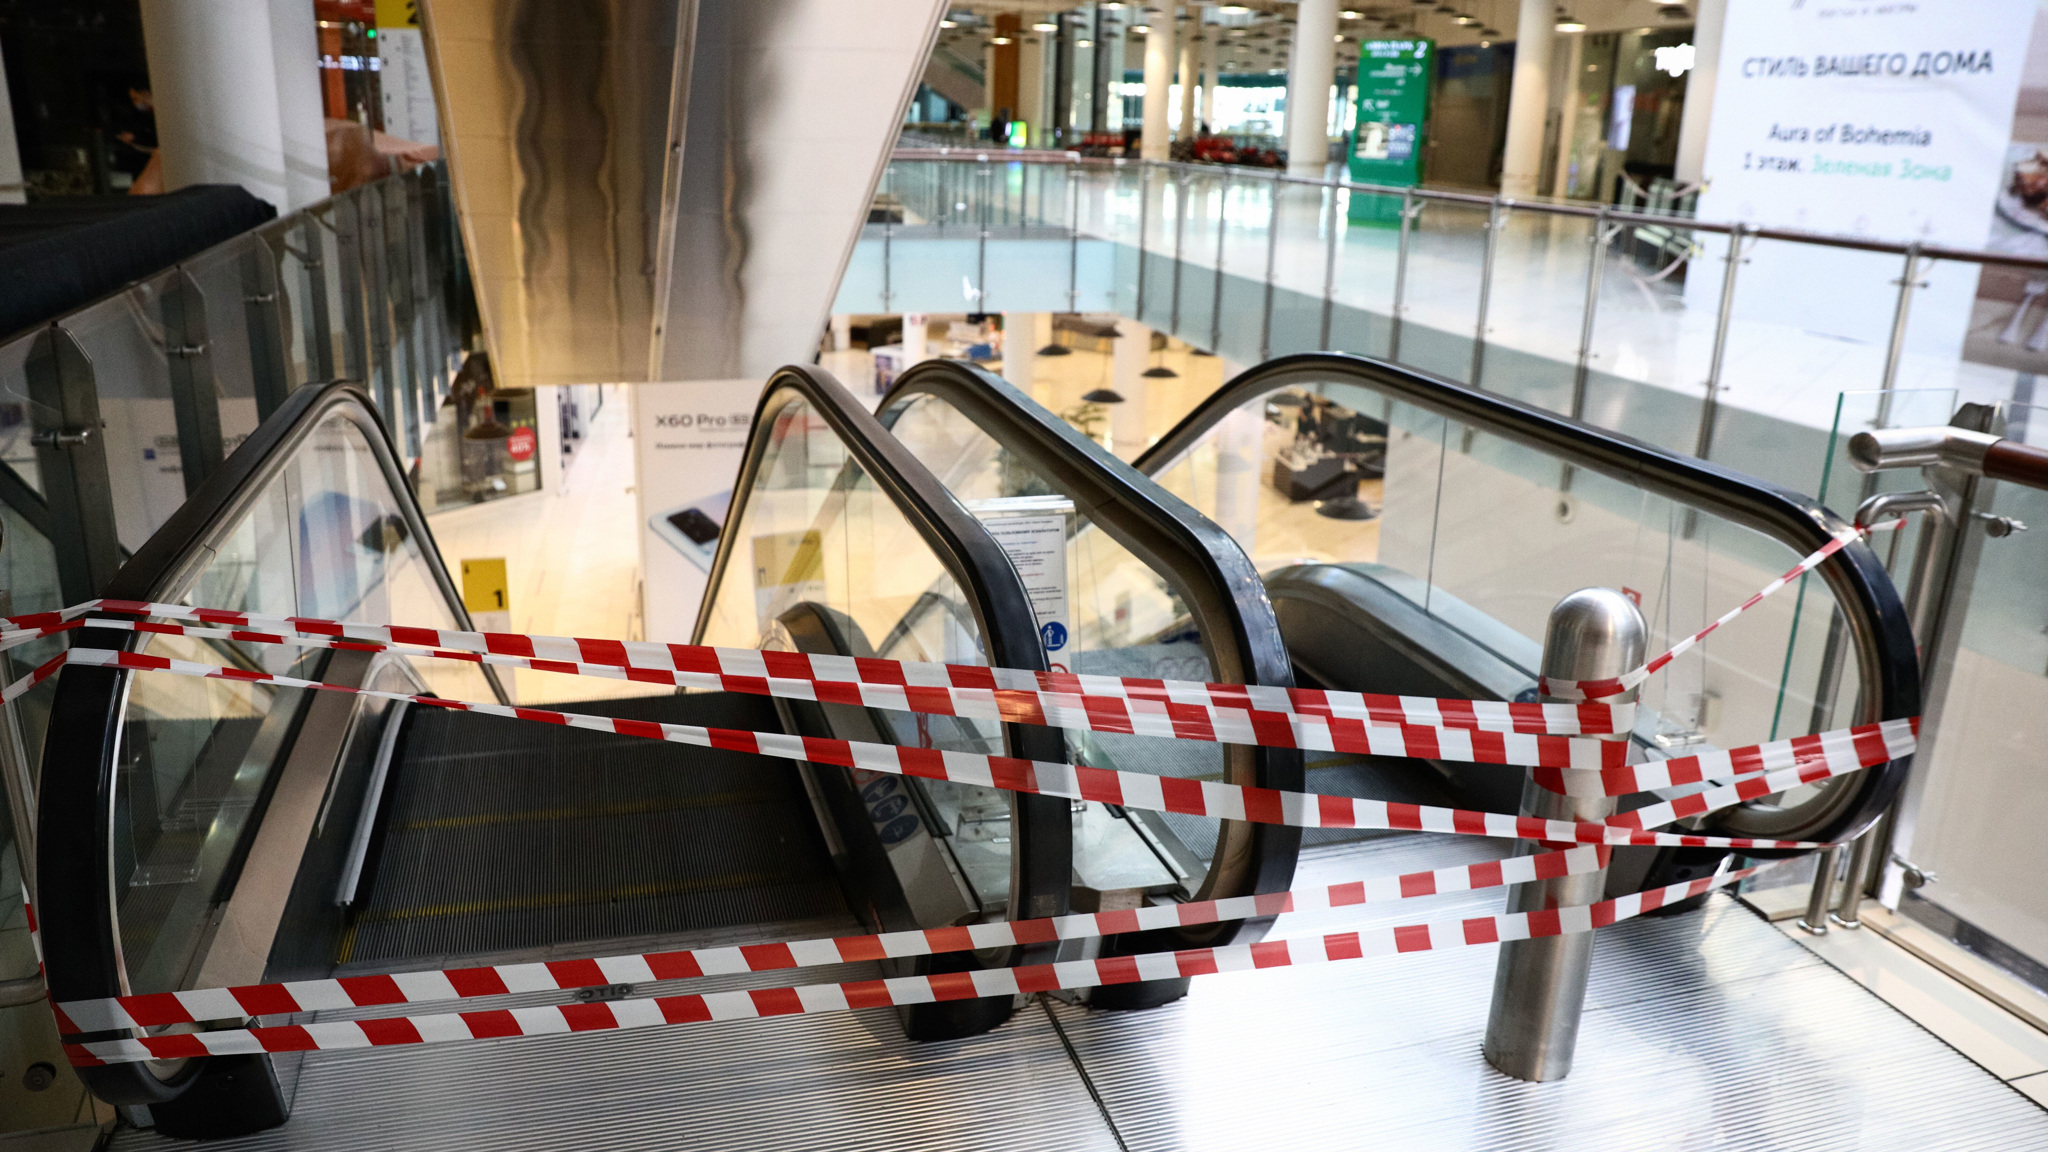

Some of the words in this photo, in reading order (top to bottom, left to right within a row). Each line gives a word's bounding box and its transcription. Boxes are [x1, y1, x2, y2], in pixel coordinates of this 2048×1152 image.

[1743, 57, 1808, 78] СТИЛЬ
[1814, 54, 1907, 77] ВАШЕГО
[1911, 51, 1993, 78] ДОМА
[1768, 124, 1808, 143] Aura
[1814, 124, 1837, 143] of
[1840, 125, 1932, 146] Bohemia
[1898, 159, 1952, 182] Зона
[656, 414, 693, 428] X60
[697, 413, 726, 427] Pro
[493, 589, 504, 608] 1
